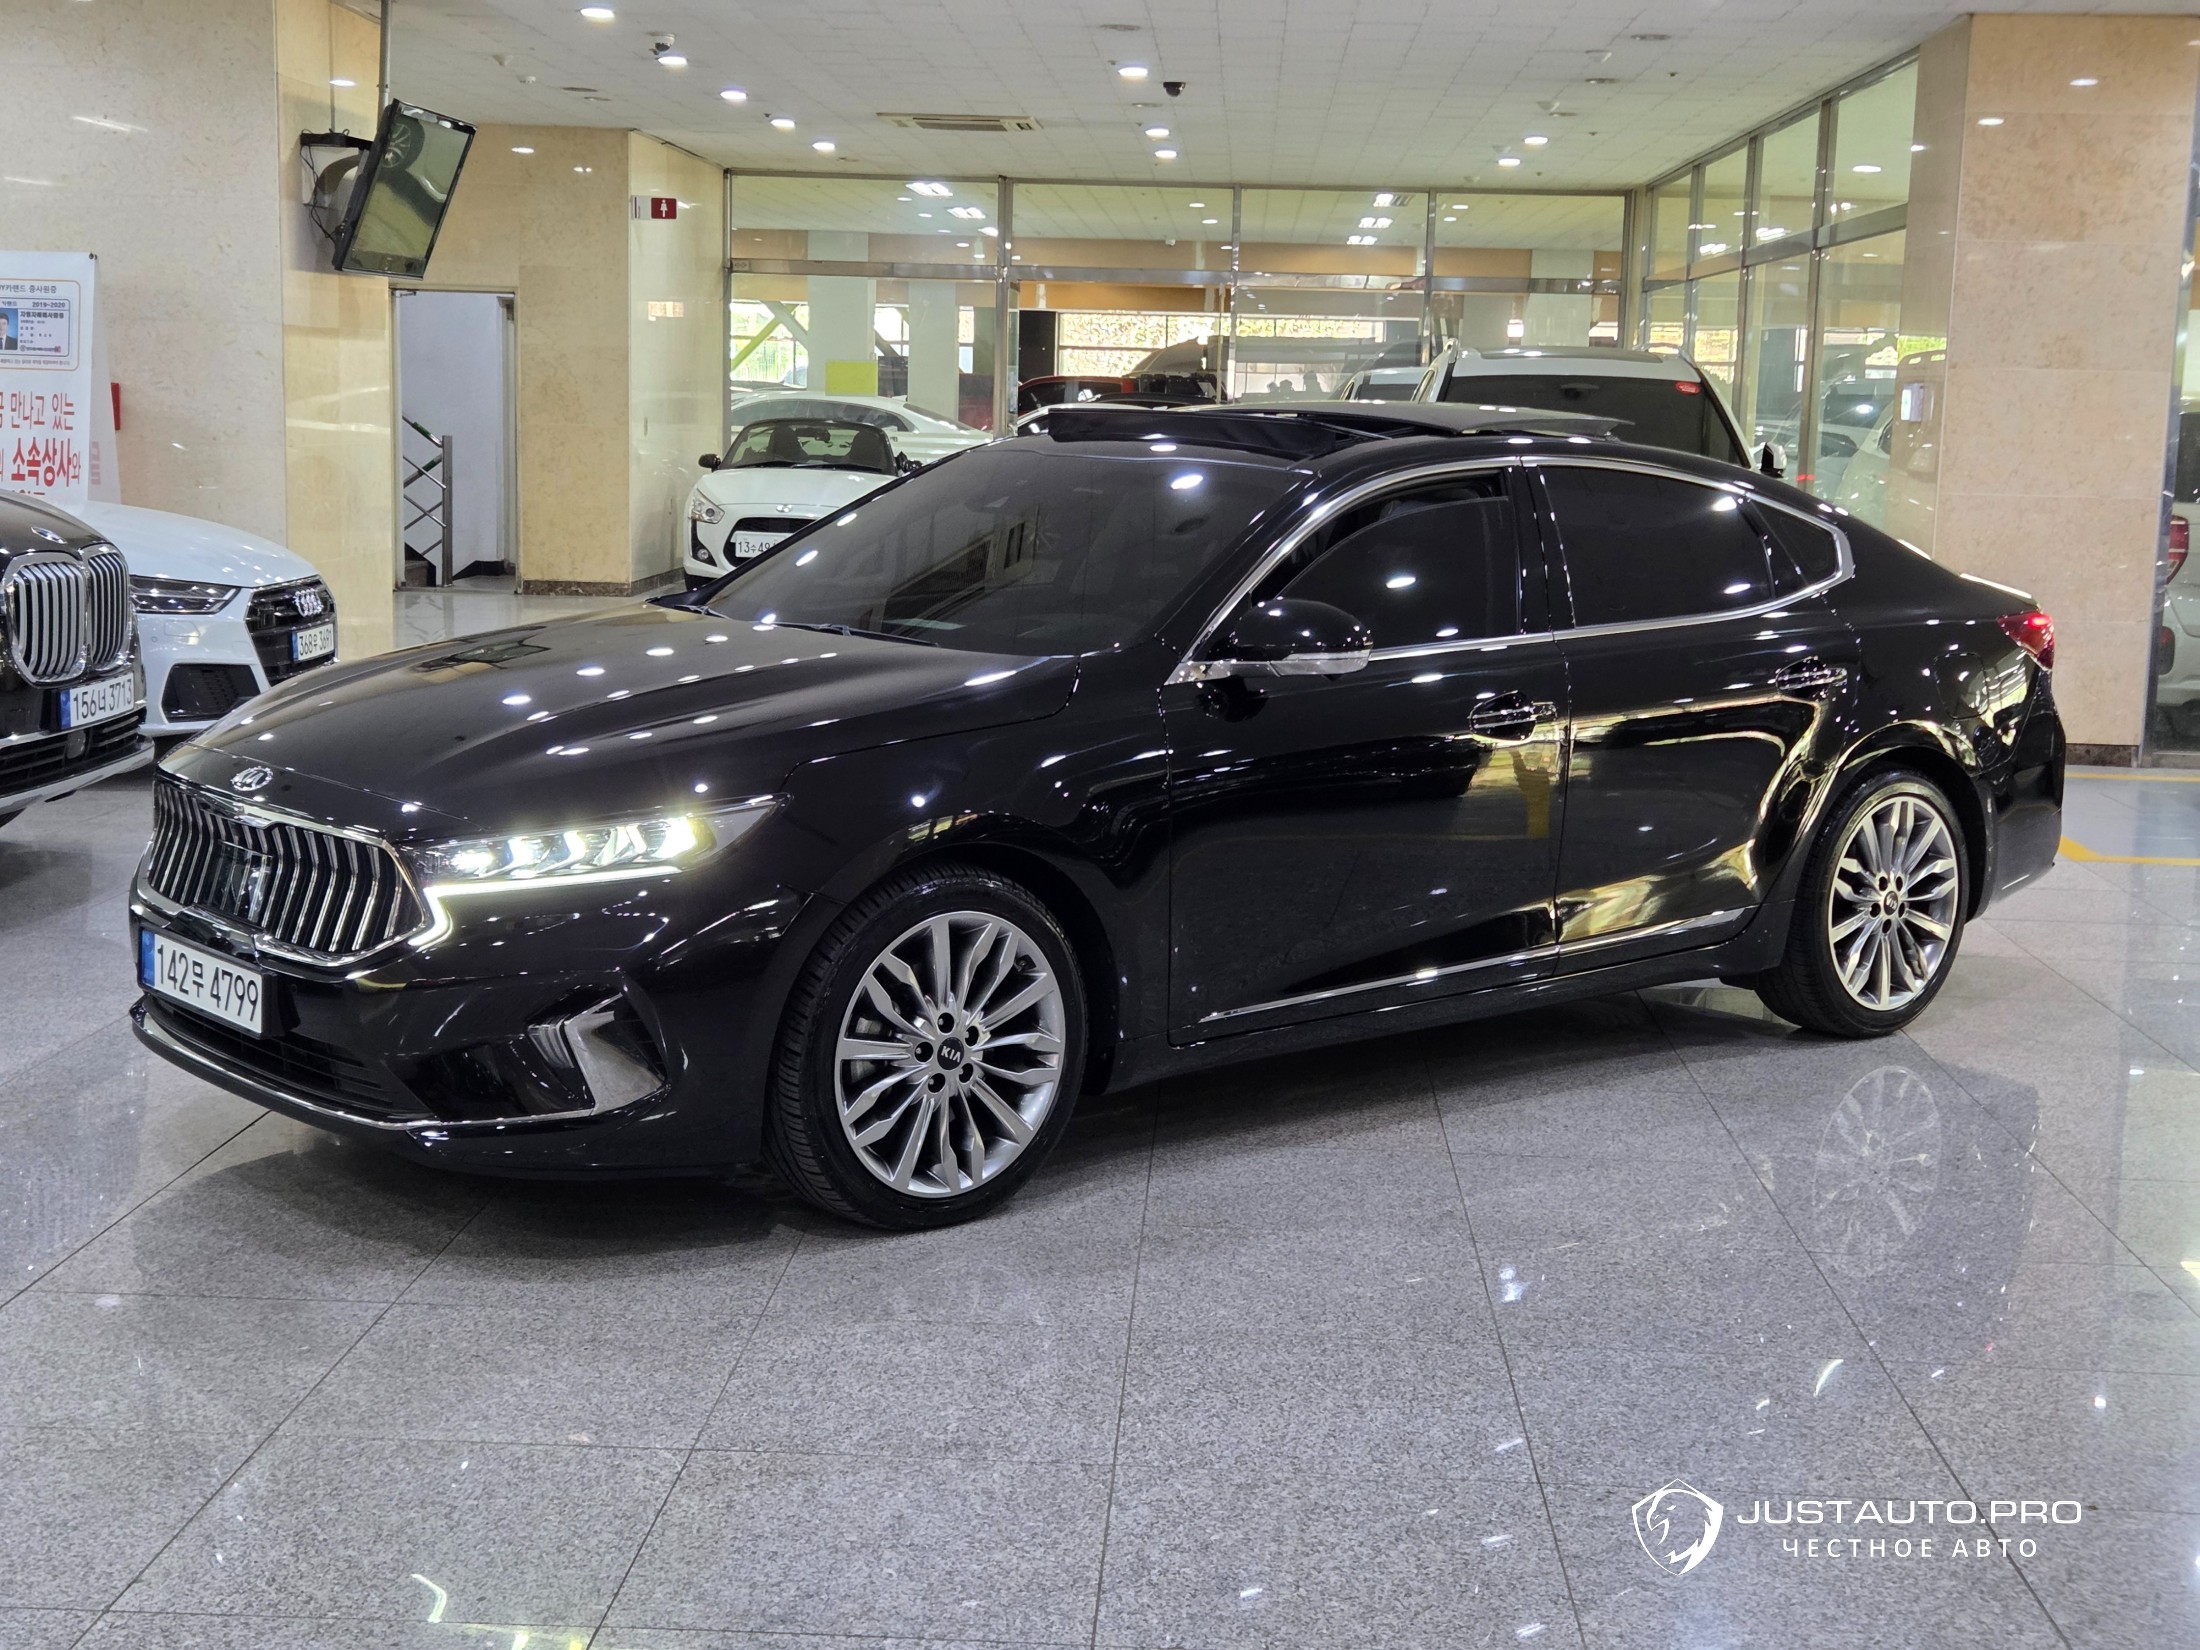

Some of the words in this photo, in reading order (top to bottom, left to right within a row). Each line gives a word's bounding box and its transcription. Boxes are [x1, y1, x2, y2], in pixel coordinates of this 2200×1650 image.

[10, 391, 45, 430] 만나고
[52, 392, 75, 431] 있는
[11, 436, 81, 488] 소속상사와
[940, 1045, 961, 1063] KIA
